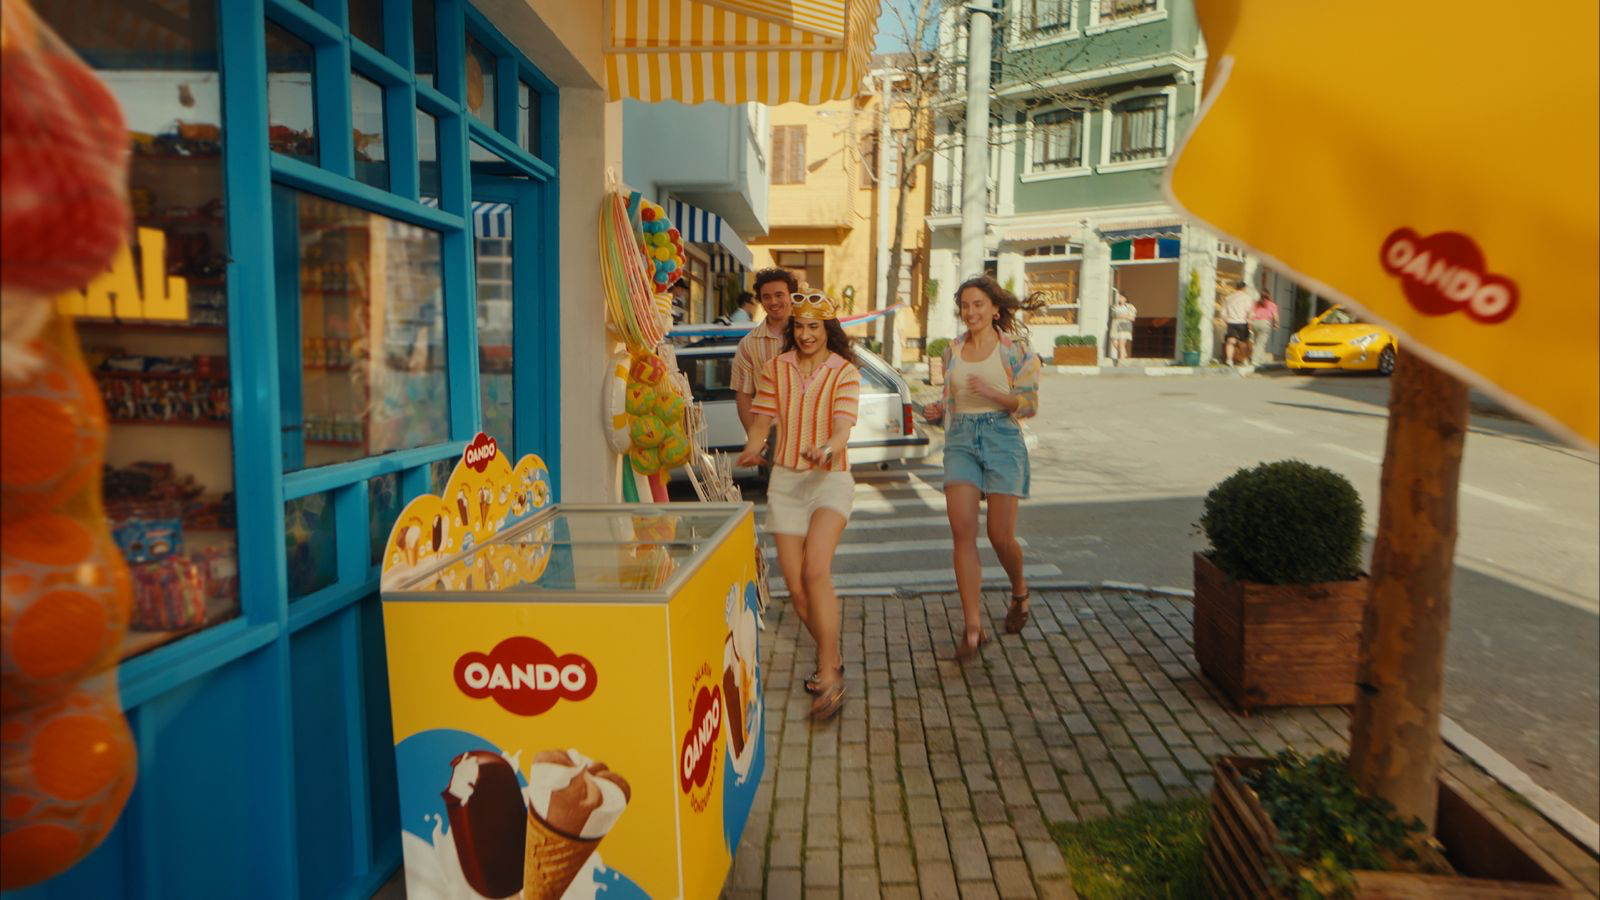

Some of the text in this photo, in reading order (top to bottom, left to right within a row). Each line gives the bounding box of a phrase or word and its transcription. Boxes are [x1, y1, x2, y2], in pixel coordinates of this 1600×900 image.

[56, 226, 188, 321] AL
[1387, 238, 1509, 316] OANDO
[467, 443, 495, 464] OANDO
[464, 662, 586, 692] OANDO
[684, 697, 720, 780] OANDO
